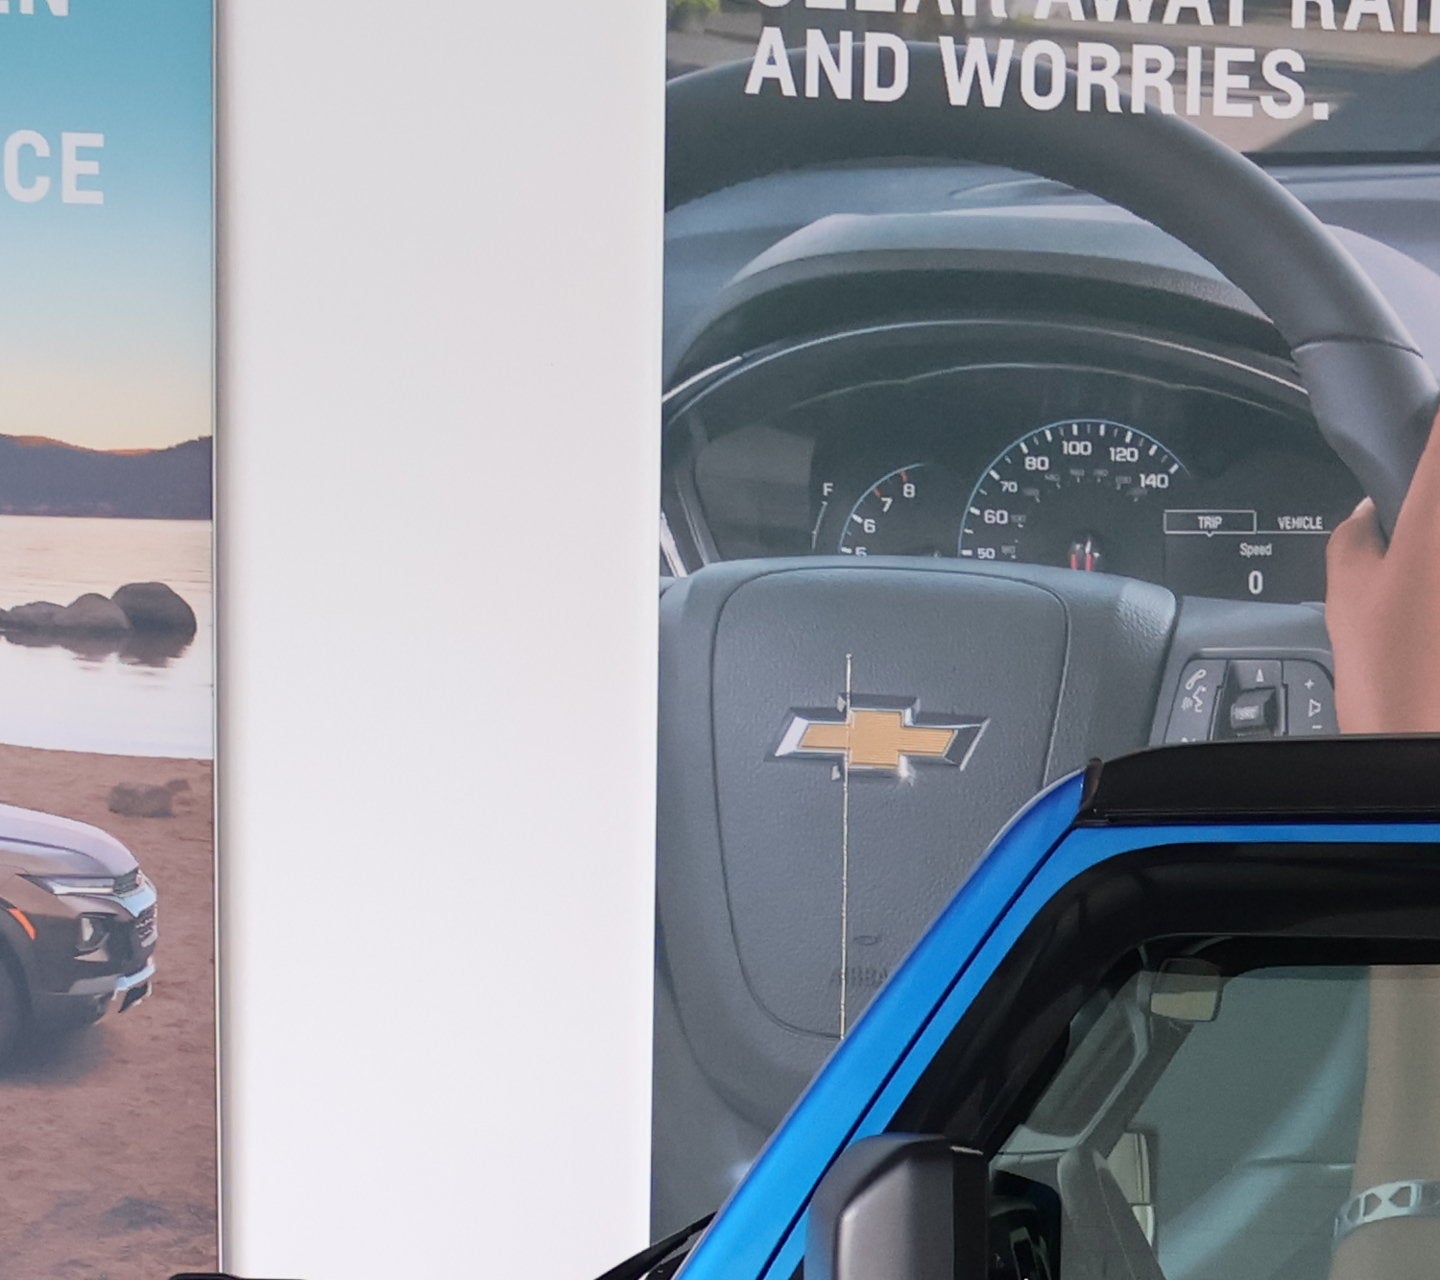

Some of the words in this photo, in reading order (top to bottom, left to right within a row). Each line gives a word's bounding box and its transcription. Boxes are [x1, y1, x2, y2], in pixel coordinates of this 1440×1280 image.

[745, 26, 909, 102] AND
[938, 36, 1330, 120] WORRIES.
[1062, 440, 1092, 456] 100
[1109, 446, 1139, 463] 120
[1024, 456, 1049, 471] 80
[1000, 480, 1018, 493] 70
[1139, 473, 1169, 489] 140
[822, 482, 834, 497] F
[902, 483, 916, 498] 8
[881, 497, 893, 513] 7
[983, 508, 1009, 525] 60
[1197, 515, 1223, 530] TRIP
[1277, 515, 1324, 530] VEHICLE
[863, 518, 876, 534] 6
[977, 547, 996, 560] 50
[1239, 542, 1273, 559] Speed
[1248, 570, 1264, 595] 0
